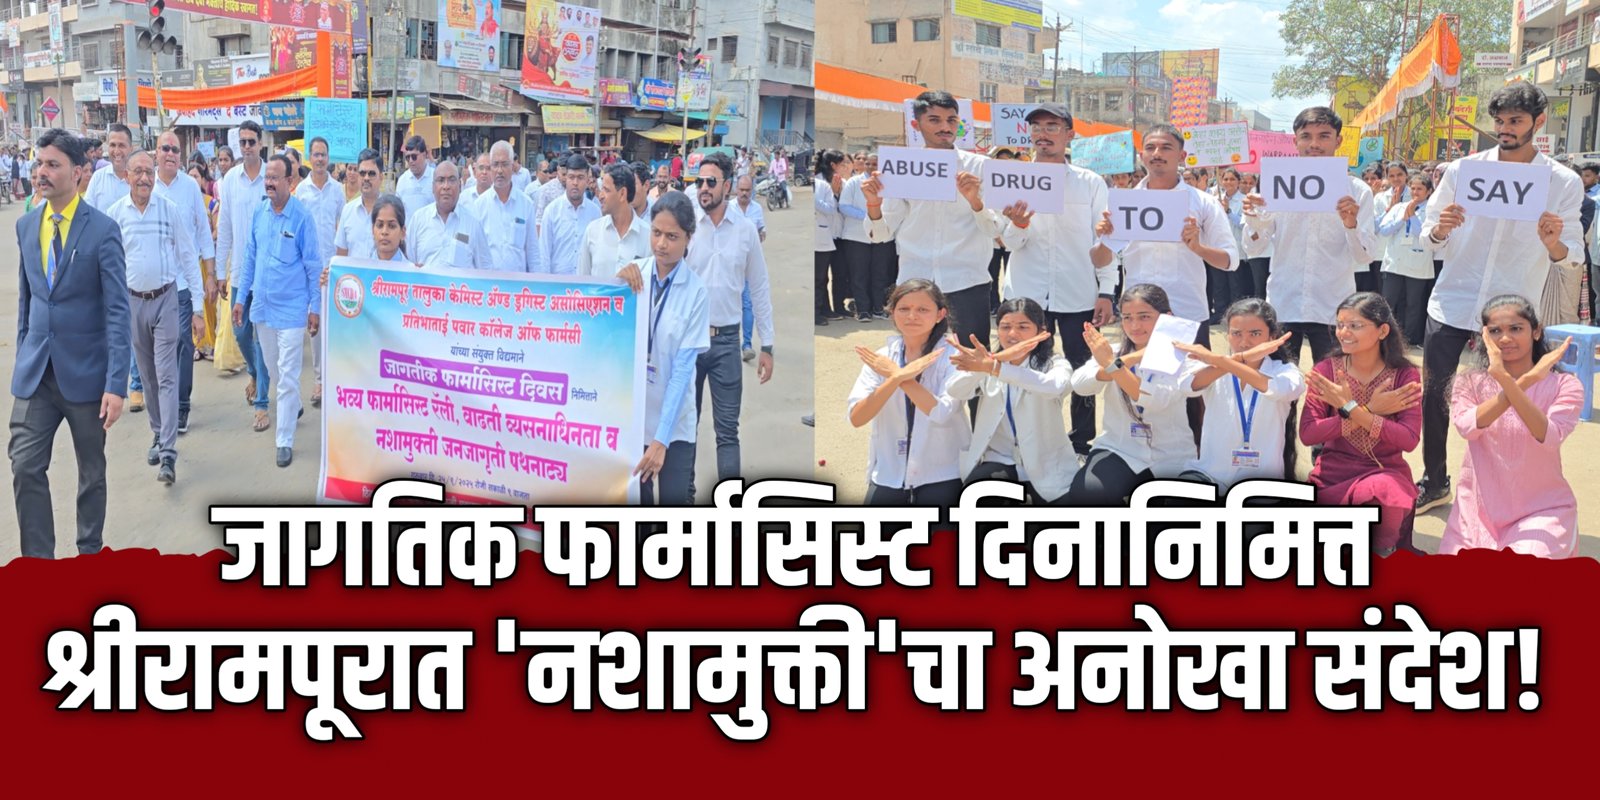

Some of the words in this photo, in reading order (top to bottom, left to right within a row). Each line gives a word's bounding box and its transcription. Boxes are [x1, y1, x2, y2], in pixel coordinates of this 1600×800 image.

[1000, 107, 1027, 120] SAY
[1016, 122, 1028, 133] N
[881, 159, 949, 178] ABUSE
[991, 172, 1052, 191] DRUG
[1273, 174, 1326, 201] NO
[1467, 178, 1534, 206] SAY
[1118, 206, 1164, 231] TO
[371, 277, 409, 304] श्रीरामपूर
[412, 285, 446, 307] तालुका
[449, 283, 483, 307] केमिस्ट
[514, 286, 547, 314] ड्रगिस्ट
[550, 288, 611, 317] असोसिएशन
[614, 296, 625, 316] व
[402, 309, 449, 337] प्रतिभाताई
[452, 319, 475, 337] पवार
[479, 318, 513, 340] कॉलेज
[517, 320, 542, 341] ऑफ
[545, 322, 582, 345] फार्मसी
[450, 343, 470, 358] यांच्या
[472, 344, 494, 364] संयुक्त
[496, 347, 525, 364] विद्यमाने
[384, 357, 438, 383] जागतीक
[441, 365, 515, 397] फार्मासिस्ट
[336, 385, 363, 410] भव्य
[368, 383, 429, 417] फार्मासिस्ट
[431, 392, 460, 427] रॅली,
[463, 403, 502, 432] वाढती
[505, 411, 601, 449] व्यसनाधिनता
[606, 425, 619, 451] व
[376, 427, 438, 463] नशामुक्ती
[441, 434, 506, 475] जनजागृती
[509, 450, 568, 483] पथनाट्य
